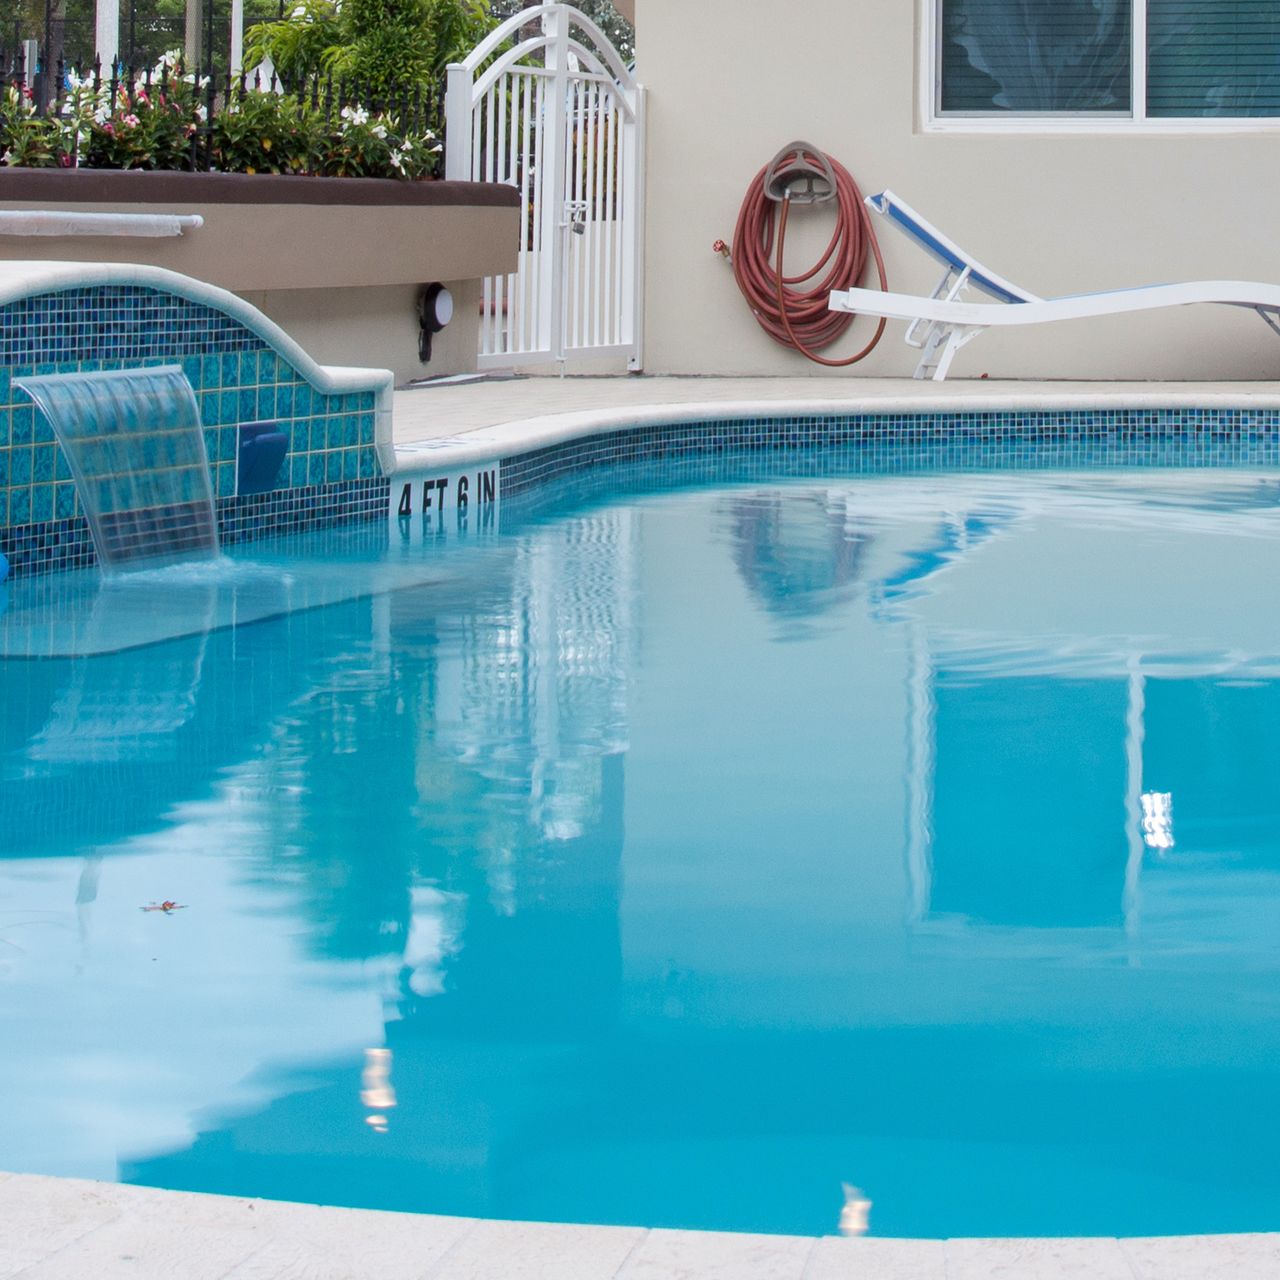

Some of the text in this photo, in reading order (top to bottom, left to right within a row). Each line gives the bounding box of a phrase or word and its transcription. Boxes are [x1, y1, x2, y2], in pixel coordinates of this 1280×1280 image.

[398, 470, 495, 516] 4 FT 6 IN
